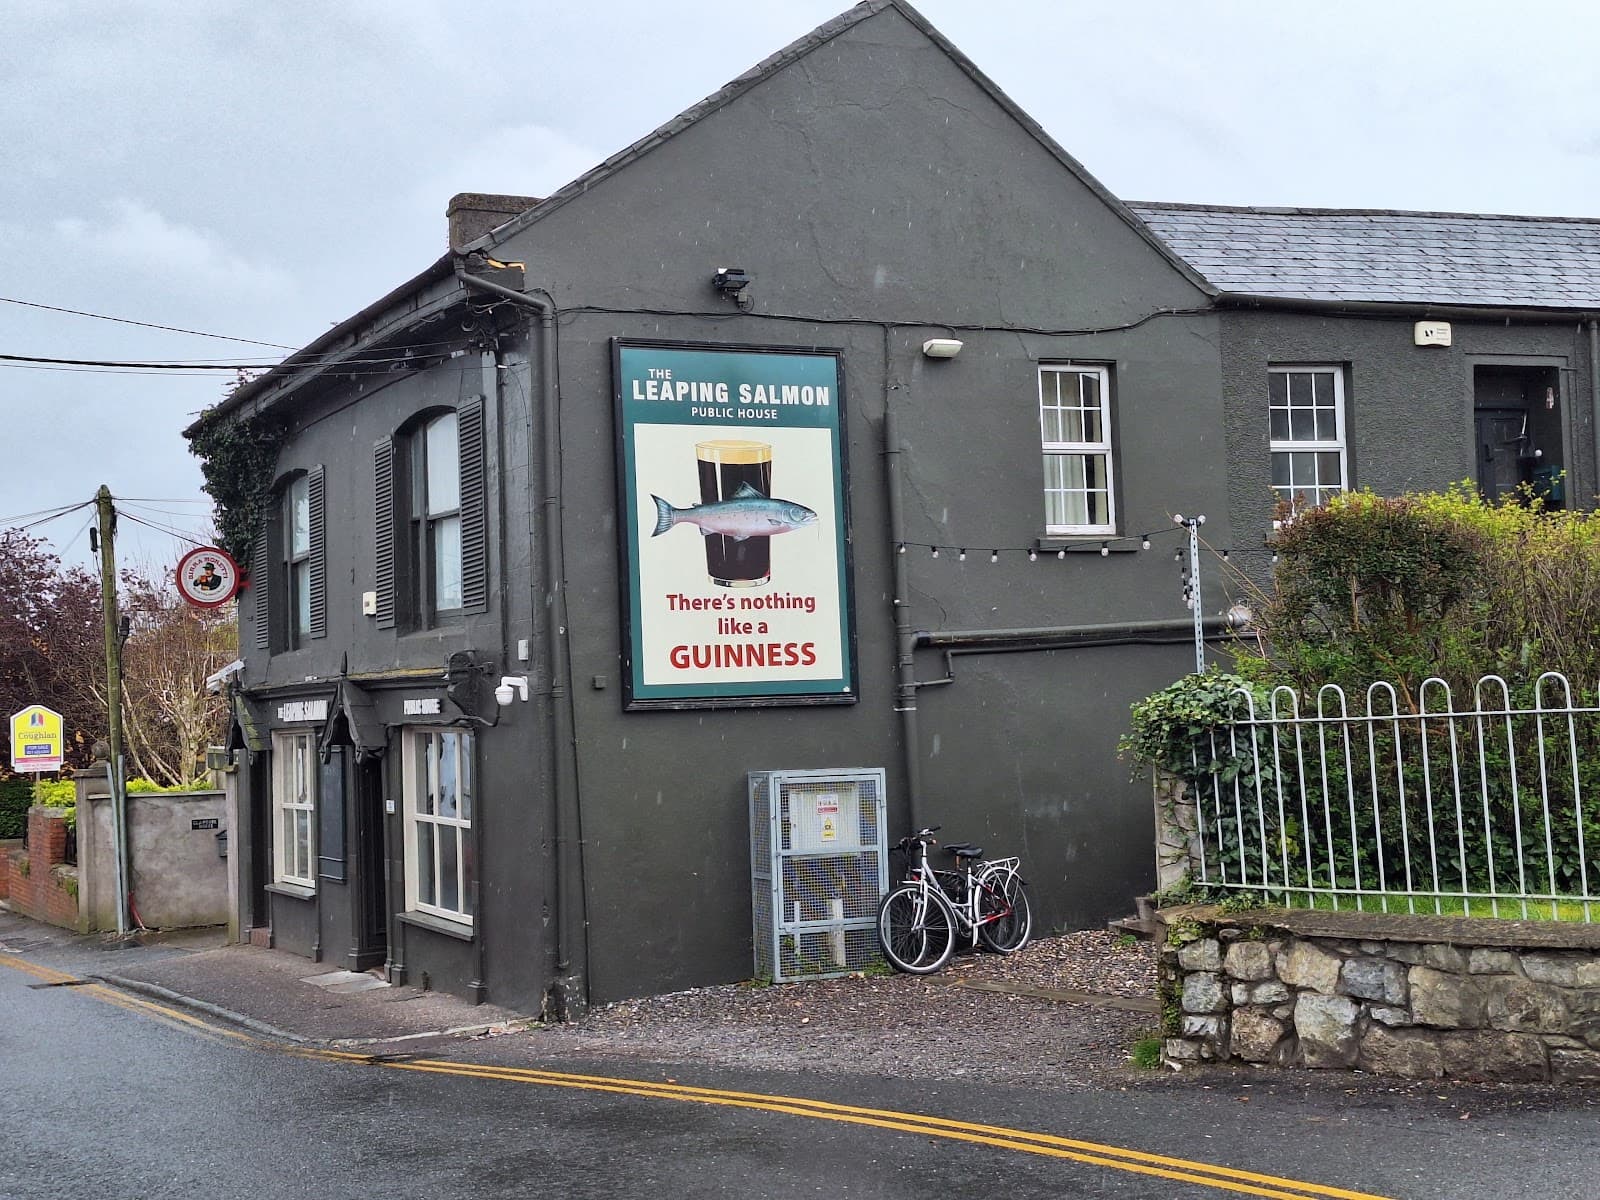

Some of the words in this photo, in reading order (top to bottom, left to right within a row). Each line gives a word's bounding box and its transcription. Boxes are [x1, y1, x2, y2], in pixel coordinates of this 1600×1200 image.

[648, 368, 672, 380] THE
[632, 379, 729, 403] LEAPING
[739, 383, 830, 406] SALMON
[691, 407, 734, 418] PUBLIC
[738, 408, 778, 419] HOUSE
[666, 594, 736, 611] There's
[740, 592, 816, 613] nothing
[718, 617, 753, 635] like
[758, 621, 768, 634] a
[669, 642, 817, 669] GUINNESS
